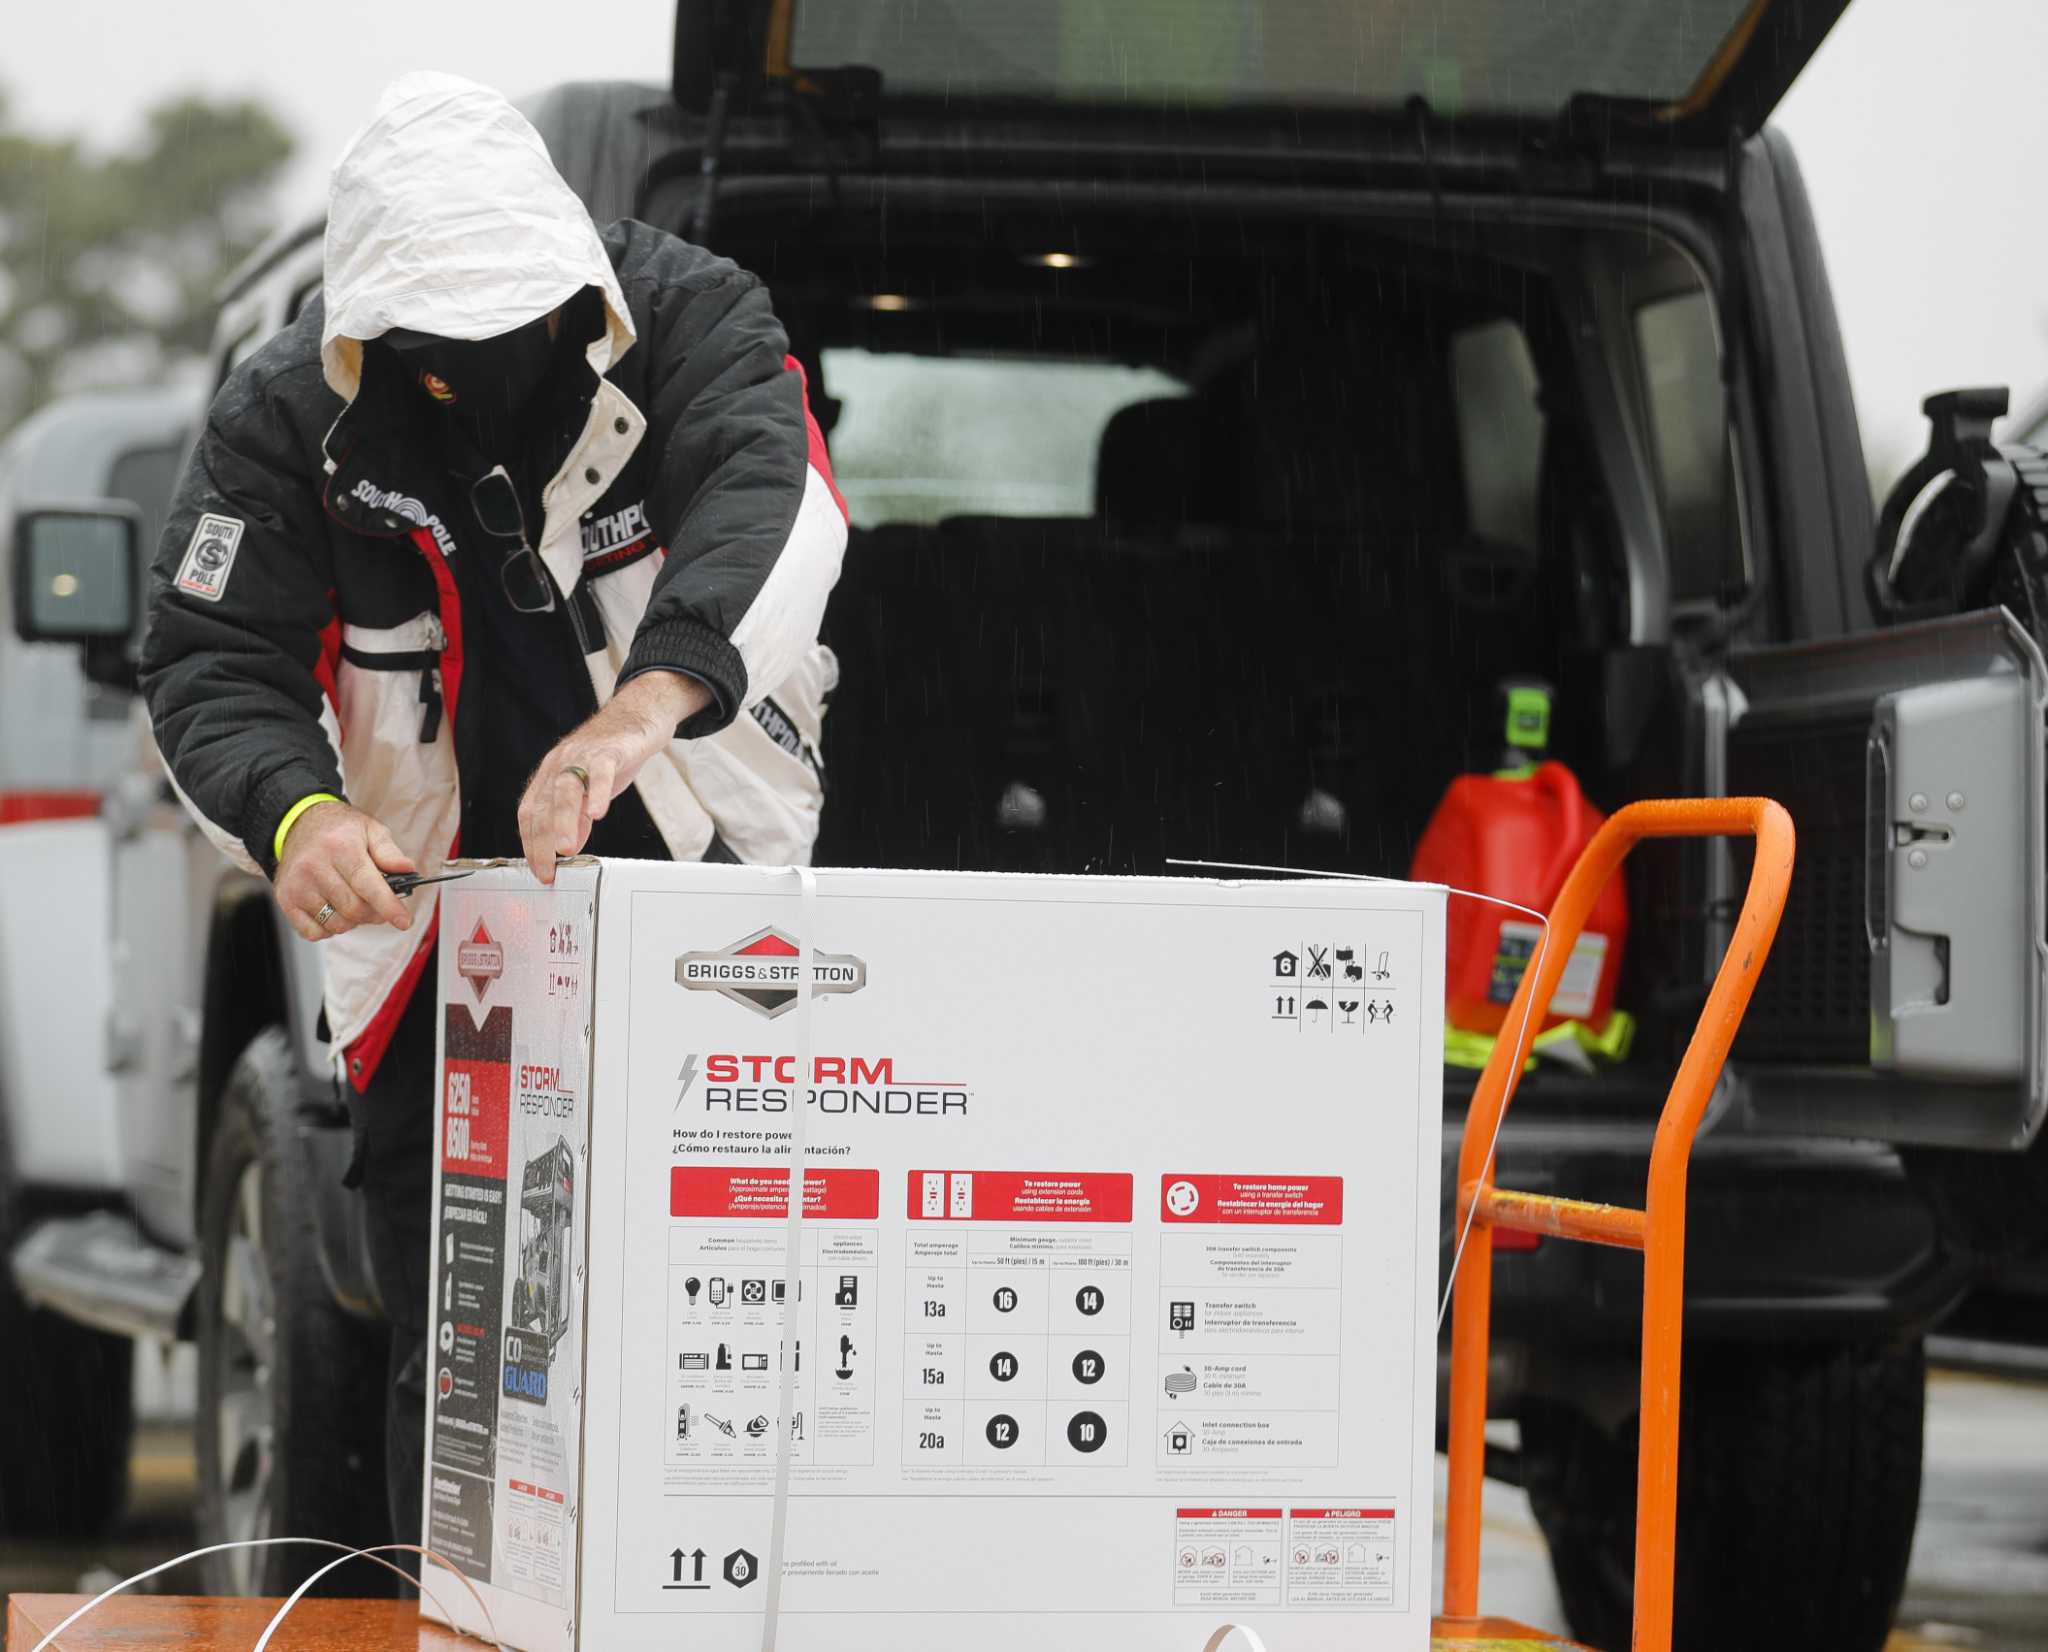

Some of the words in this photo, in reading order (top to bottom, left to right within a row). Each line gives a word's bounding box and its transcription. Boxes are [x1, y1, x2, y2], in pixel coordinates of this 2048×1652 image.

[351, 479, 404, 510] SOUTH
[205, 522, 233, 539] SOUTH
[424, 514, 456, 556] POLE
[189, 569, 216, 586] POLE
[1280, 957, 1292, 974] 6
[521, 1065, 560, 1091] STORM
[520, 1094, 573, 1119] RESPONDER
[673, 1129, 698, 1139] How
[700, 1129, 713, 1139] do
[717, 1130, 720, 1139] I
[722, 1131, 762, 1140] restore
[673, 1143, 710, 1155] ¿Cómo
[713, 1144, 759, 1153] restauro
[762, 1144, 771, 1153] la
[730, 1178, 748, 1186] What
[749, 1178, 758, 1186] do
[759, 1179, 772, 1187] you
[803, 1179, 826, 1187] ower?
[735, 1194, 752, 1203] ¿Qué
[753, 1195, 783, 1203] necesita
[1015, 1197, 1055, 1205] Restablecer
[1304, 1202, 1323, 1210] hogar
[997, 1257, 1004, 1265] 50
[1005, 1257, 1010, 1265] ft
[1011, 1258, 1027, 1267] (pies)
[1093, 1259, 1110, 1267] (pies)
[998, 1291, 1013, 1309] 16
[1083, 1292, 1097, 1310] 14
[924, 1301, 946, 1317] 13a
[506, 1336, 522, 1362] CO
[996, 1358, 1011, 1376] 14
[1082, 1359, 1096, 1377] 12
[504, 1364, 546, 1399] GUARD
[922, 1368, 945, 1385] 15a
[919, 1432, 944, 1449] 20a
[995, 1423, 1010, 1441] 12
[1080, 1423, 1095, 1442] 10
[1331, 1510, 1361, 1518] PELIGRO
[735, 1566, 746, 1577] 30
